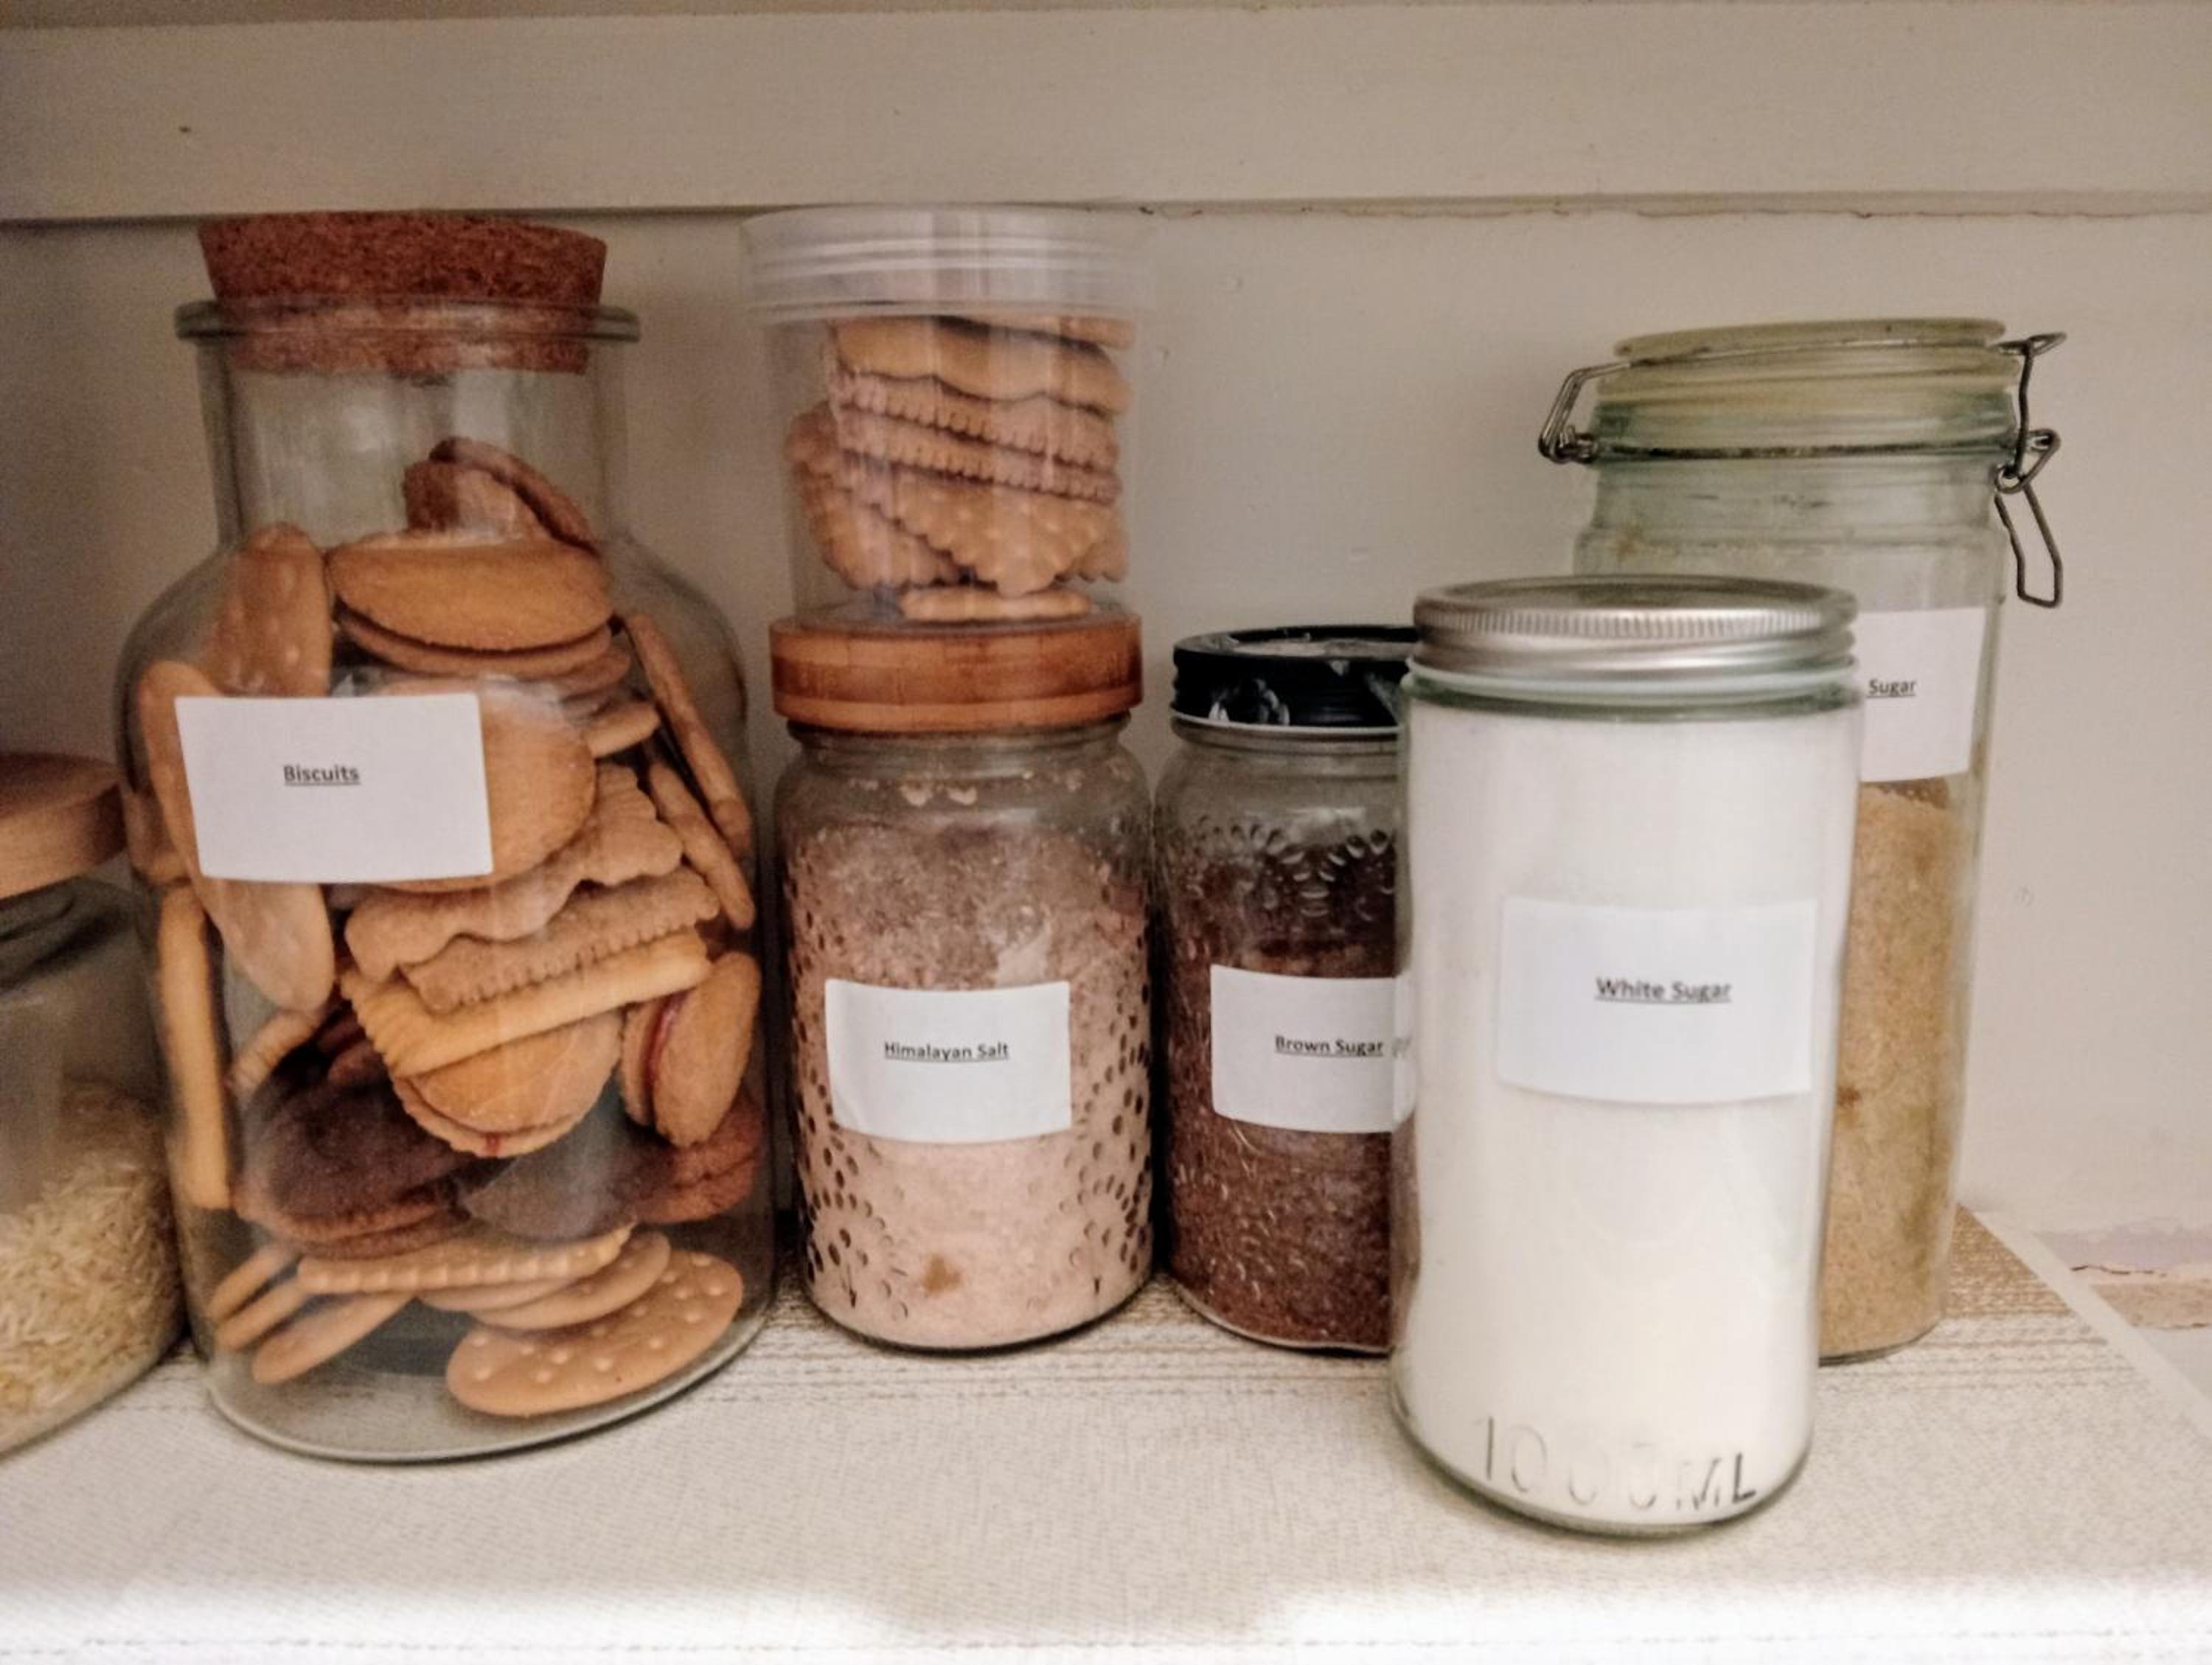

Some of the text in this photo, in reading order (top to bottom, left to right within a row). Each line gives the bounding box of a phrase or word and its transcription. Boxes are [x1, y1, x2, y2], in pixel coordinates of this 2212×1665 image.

[1868, 678, 1917, 697] Sugar
[283, 764, 361, 785] Biscuits
[1595, 976, 1733, 1004] White Sugar
[884, 1041, 1009, 1061] Himalayan Salt
[1275, 1035, 1331, 1055] Brown
[1335, 1038, 1384, 1057] Sugar
